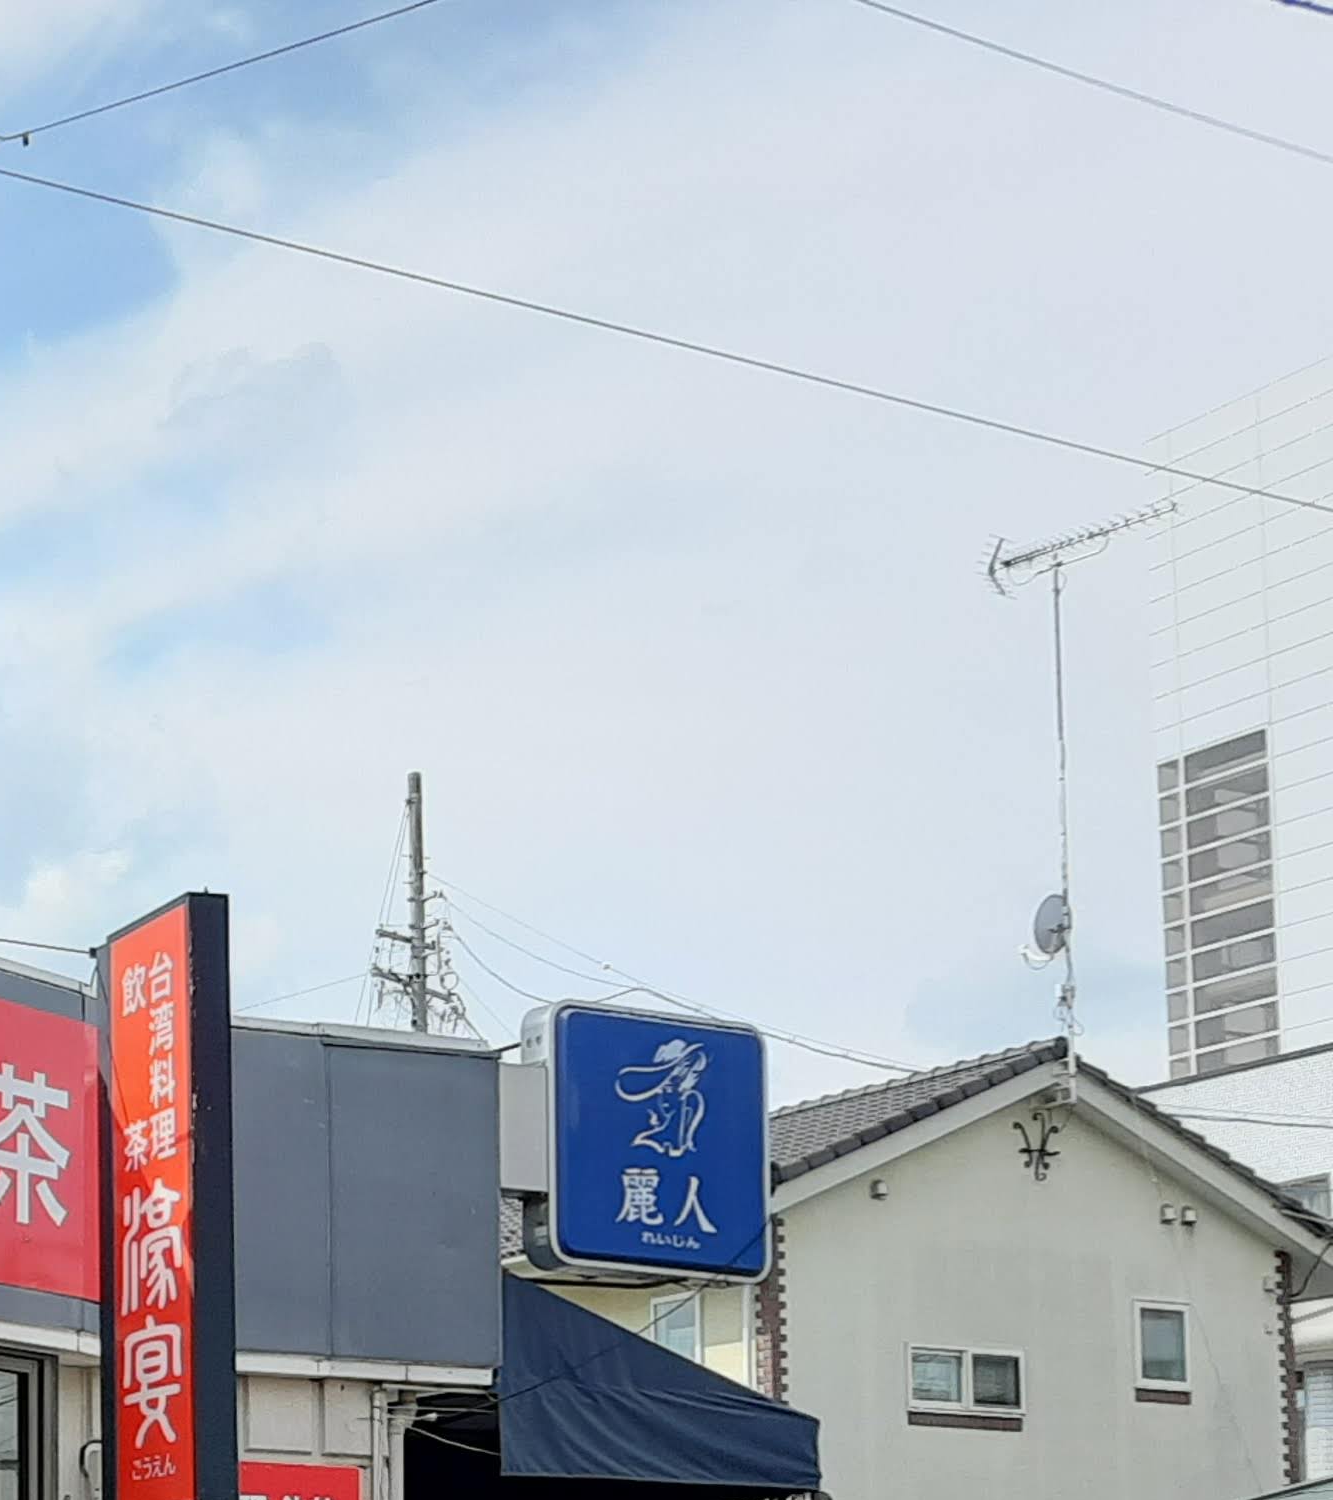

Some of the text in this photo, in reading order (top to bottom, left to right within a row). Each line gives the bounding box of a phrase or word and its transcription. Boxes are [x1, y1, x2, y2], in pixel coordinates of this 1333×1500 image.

[149, 952, 177, 1161] 台湾料理
[615, 1168, 718, 1233] 麗人
[641, 1231, 702, 1250] れいじん
[131, 1453, 177, 1481] こうえん
